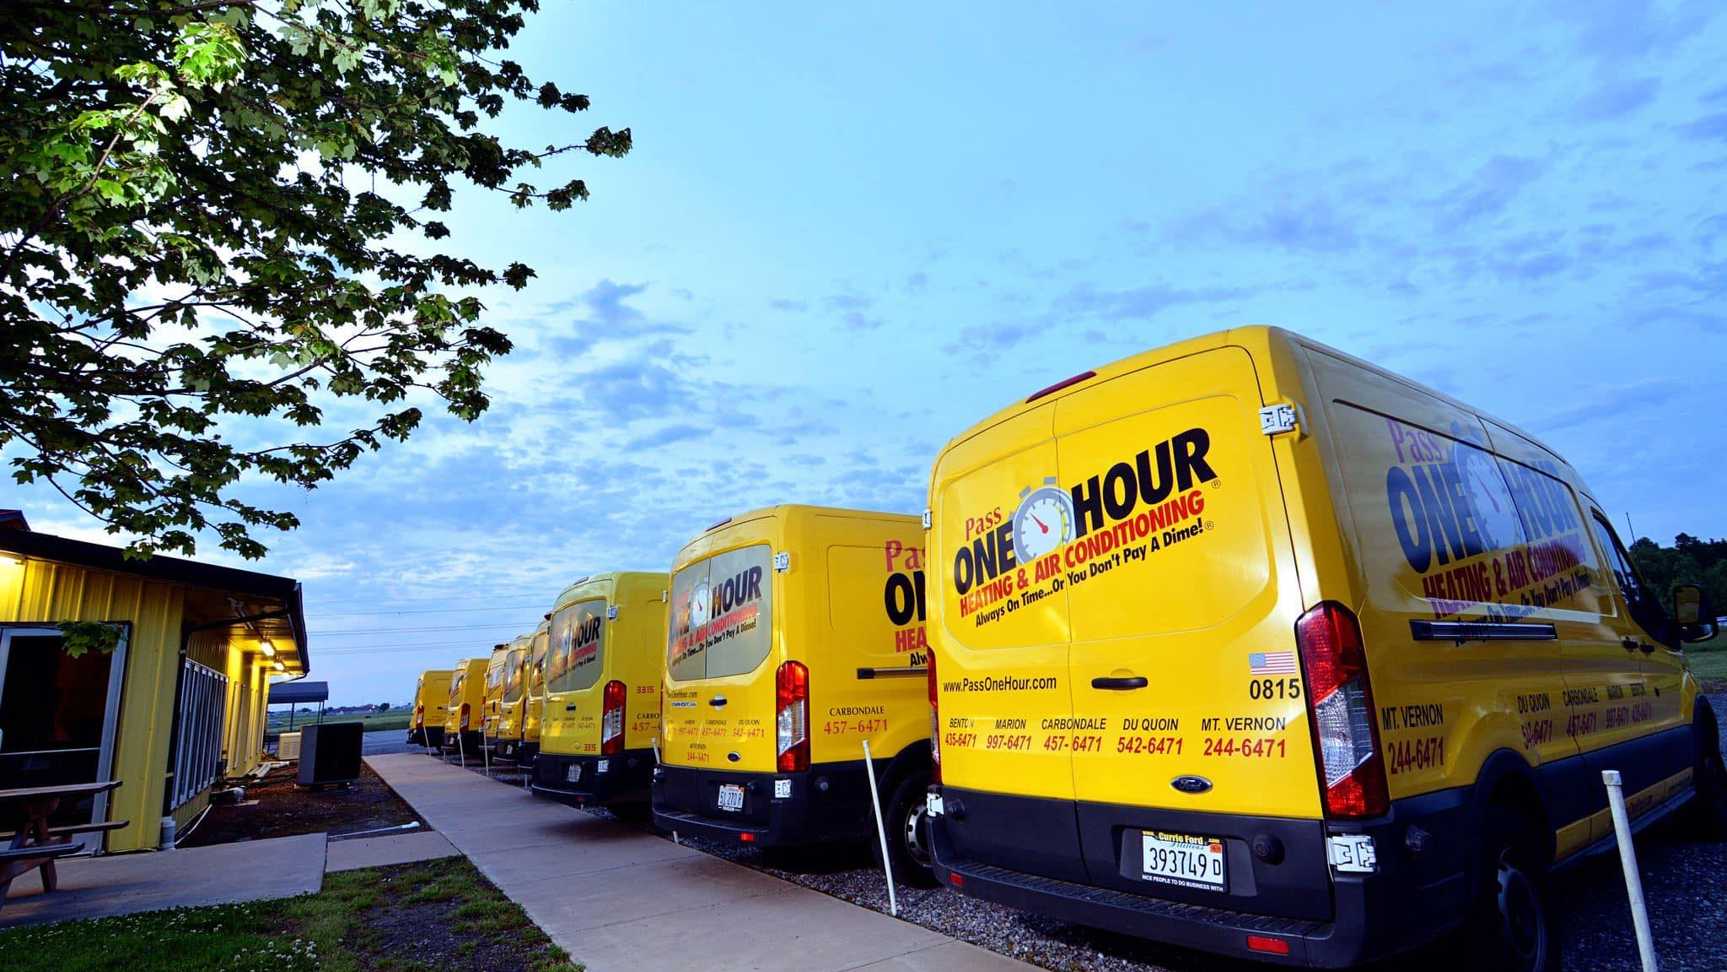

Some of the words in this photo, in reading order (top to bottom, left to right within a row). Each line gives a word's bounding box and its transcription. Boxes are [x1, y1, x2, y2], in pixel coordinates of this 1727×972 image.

[1386, 418, 1443, 463] Pass
[954, 520, 1017, 595] ONE
[1071, 427, 1218, 539] HOUR
[1386, 464, 1484, 574] ONE
[965, 507, 1002, 541] Pass
[885, 540, 926, 572] Pa
[960, 575, 1013, 618] HEATING
[1016, 568, 1029, 590] &
[1035, 553, 1062, 584] AIR
[1064, 490, 1205, 568] CONDITIONING
[976, 606, 1006, 628] Always
[1006, 599, 1020, 613] On
[1067, 570, 1087, 586] You
[1089, 553, 1121, 577] Don't
[1123, 544, 1147, 562] Pay
[1150, 537, 1160, 552] A
[1163, 517, 1204, 547] Dime!
[1422, 561, 1492, 618] HEATING
[1492, 558, 1508, 598] &
[1505, 550, 1529, 591] AIR
[711, 566, 762, 620] HOUR
[943, 676, 1057, 692] www.PassOneHour.com
[1249, 678, 1301, 700] 0815
[829, 705, 884, 717] CARBONDALE
[1382, 707, 1400, 730] MT.
[1400, 703, 1444, 729] VERNON
[824, 719, 888, 736] 457-6471
[995, 719, 1027, 730] MARION
[1041, 718, 1107, 730] CARBONDALE
[1122, 718, 1139, 731] DU
[1141, 718, 1179, 732] QUOIN
[1201, 717, 1221, 731] MT.
[1225, 717, 1286, 731] VERNON
[945, 733, 977, 748] 435-6471
[986, 735, 1032, 751] 997-6471
[1117, 737, 1184, 755] 542-6471
[1203, 738, 1286, 758] 244-6471
[1388, 736, 1444, 775] 244-6471
[1149, 847, 1207, 878] 393749
[1213, 859, 1221, 876] D
